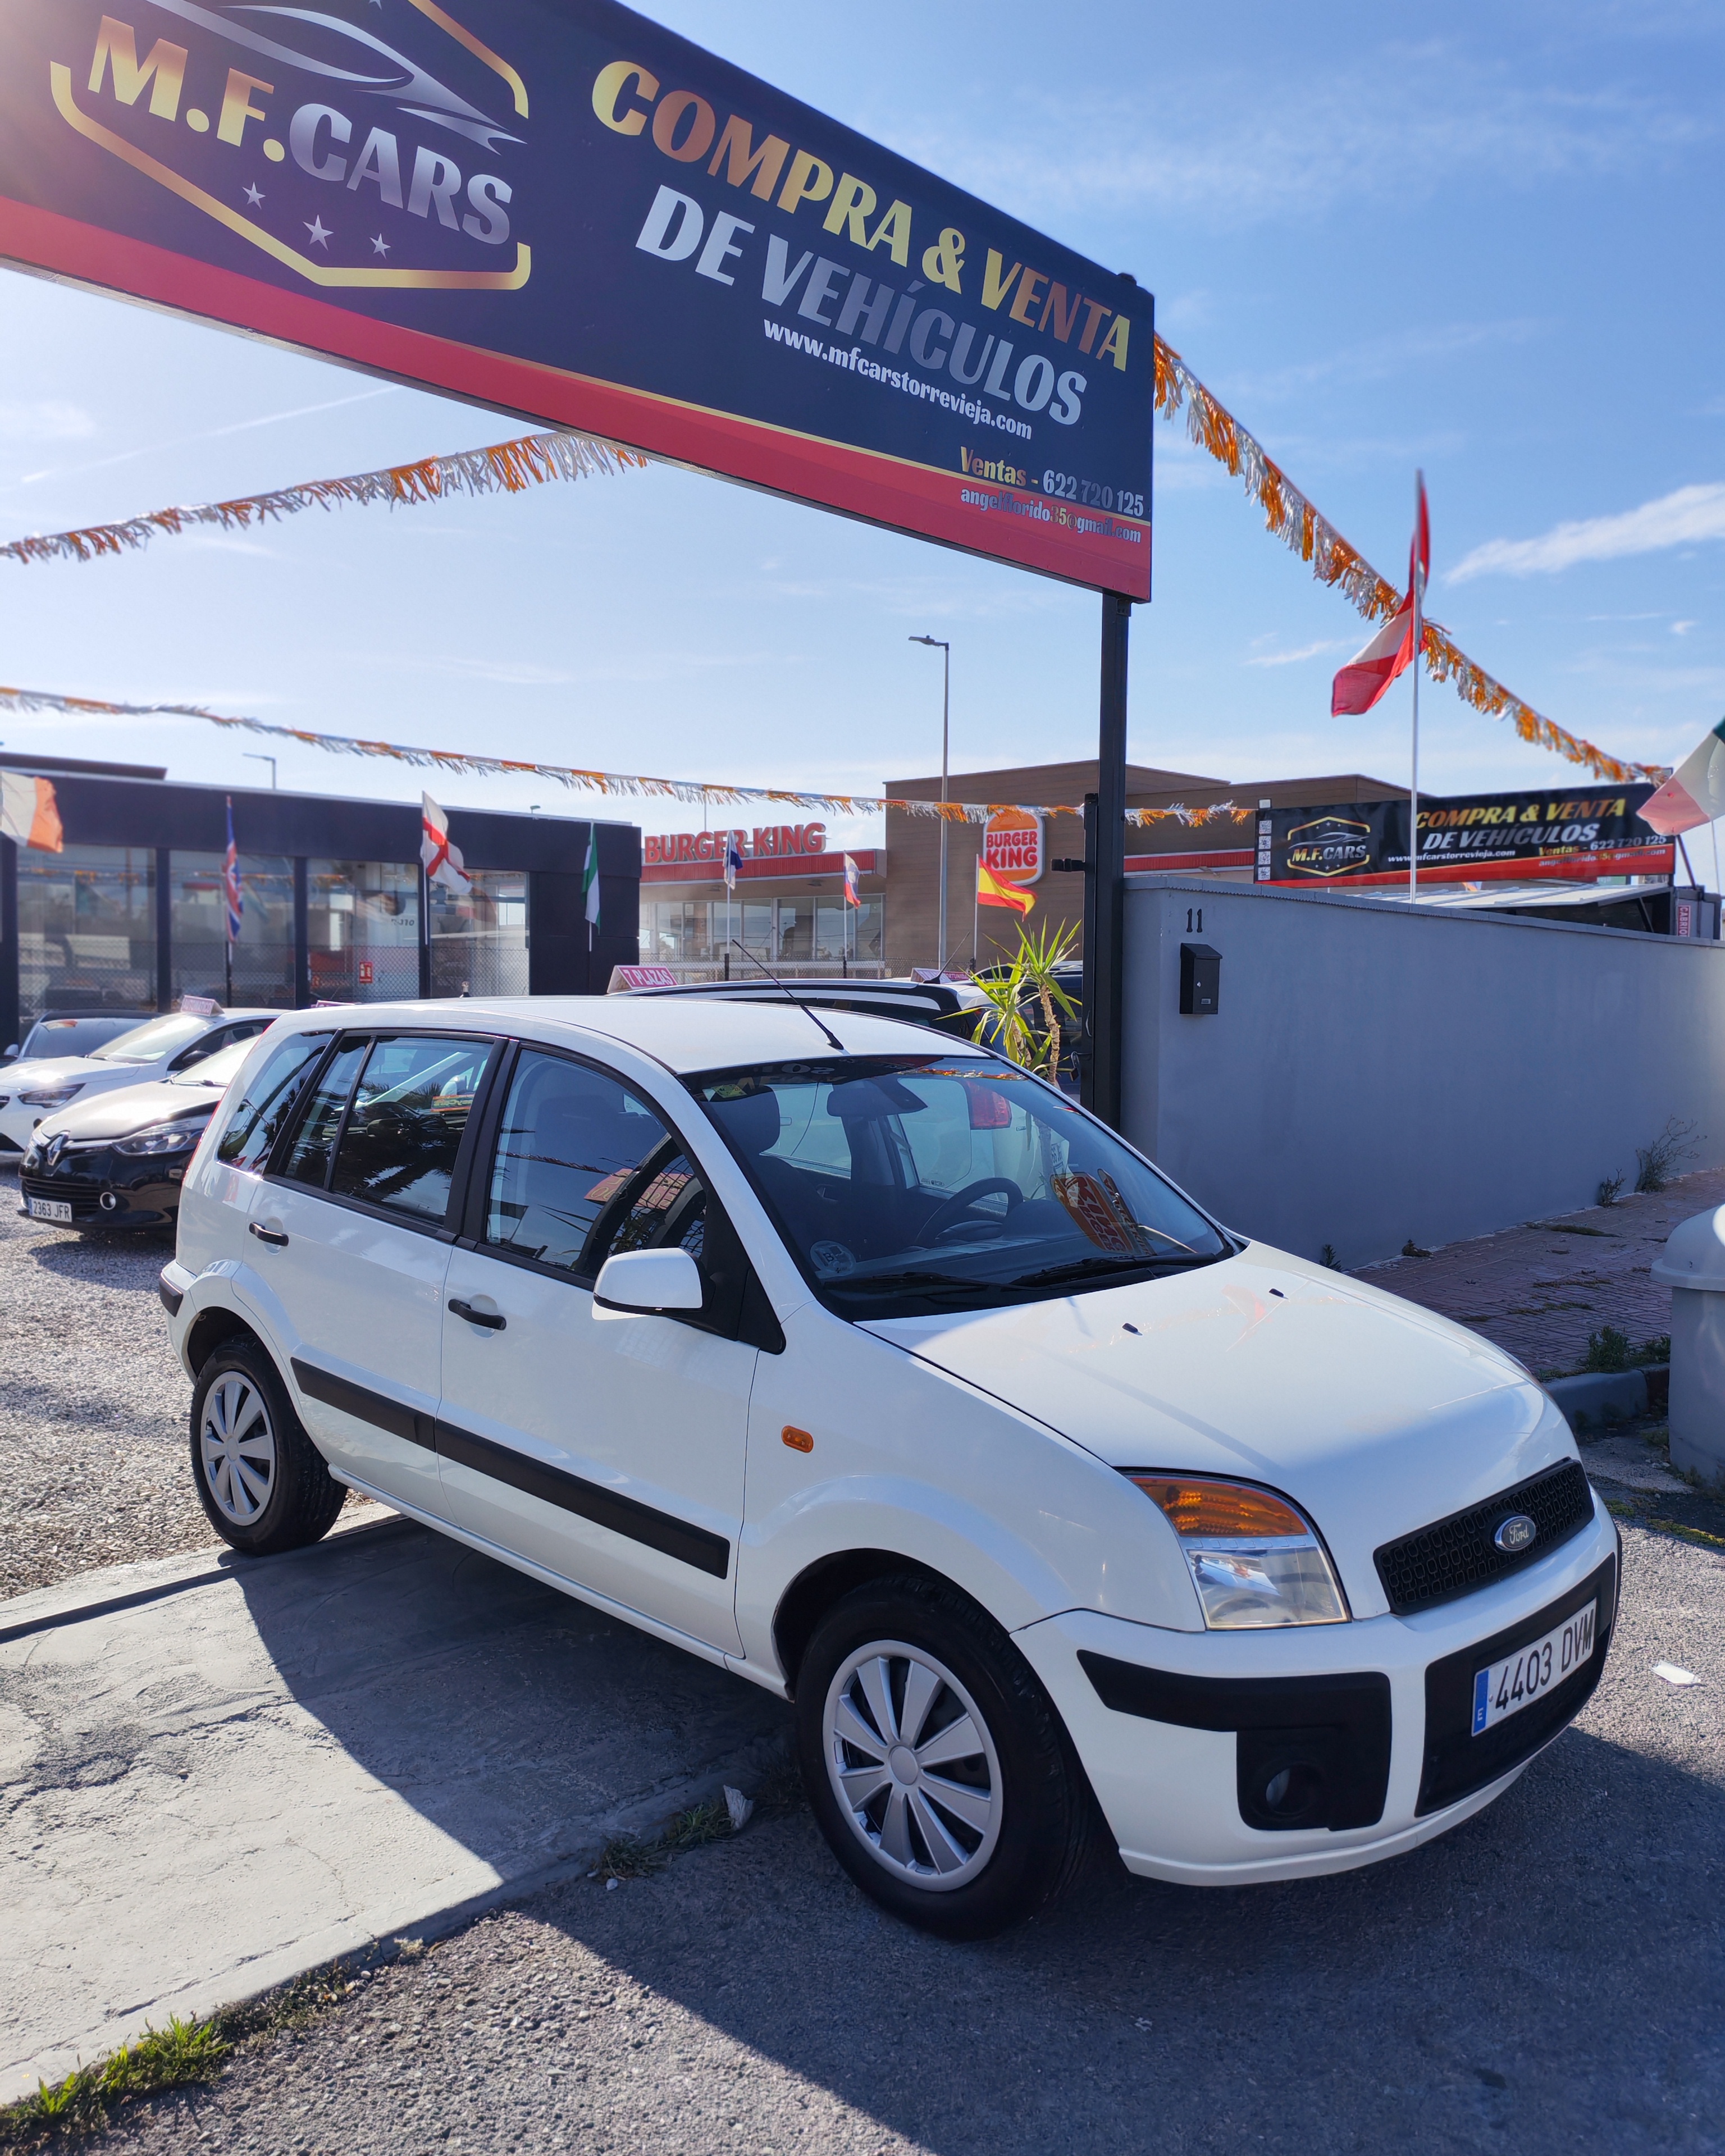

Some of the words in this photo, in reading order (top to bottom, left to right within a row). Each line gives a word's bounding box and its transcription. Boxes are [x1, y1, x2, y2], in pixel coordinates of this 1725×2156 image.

[88, 15, 513, 244] M.F.CARS
[591, 61, 912, 267] COMPRA
[921, 227, 966, 294] &
[980, 248, 1131, 371] VENTA
[635, 184, 755, 285] DE
[761, 233, 1087, 424] VEHÍCULOS
[764, 319, 1032, 440] www.mfcarstorrevieja.com
[961, 446, 1026, 486] Ventas
[1043, 469, 1077, 500] 622
[1081, 479, 1113, 509] 720
[1117, 490, 1144, 517] 125
[961, 488, 1141, 543] angelflorido35@gmail.com
[1416, 806, 1517, 829] COMPRA
[1519, 804, 1540, 821] &
[1546, 798, 1626, 820] VENTA
[645, 829, 748, 864] BURGER
[753, 822, 827, 857] KING
[986, 831, 1038, 848] BURGER
[1422, 832, 1458, 850] DE
[1459, 823, 1600, 848] VEHÍCULOS
[1539, 845, 1580, 856] Ventas
[1590, 839, 1614, 851] 622
[1618, 837, 1641, 847] 720
[1645, 835, 1667, 845] 125
[986, 846, 1038, 869] KING
[1292, 845, 1366, 862] M.F.CARS
[1388, 849, 1516, 862] wwwmfcarstorrevieja.com
[1186, 908, 1203, 933] 11
[622, 969, 636, 985] 7
[631, 969, 674, 985] PLAZAS
[33, 1200, 52, 1217] 2363
[54, 1204, 70, 1220] JFR
[1509, 1523, 1529, 1545] Ford
[1495, 1641, 1553, 1711] 4403
[1561, 1607, 1594, 1674] DVM
[1477, 1707, 1484, 1722] E
